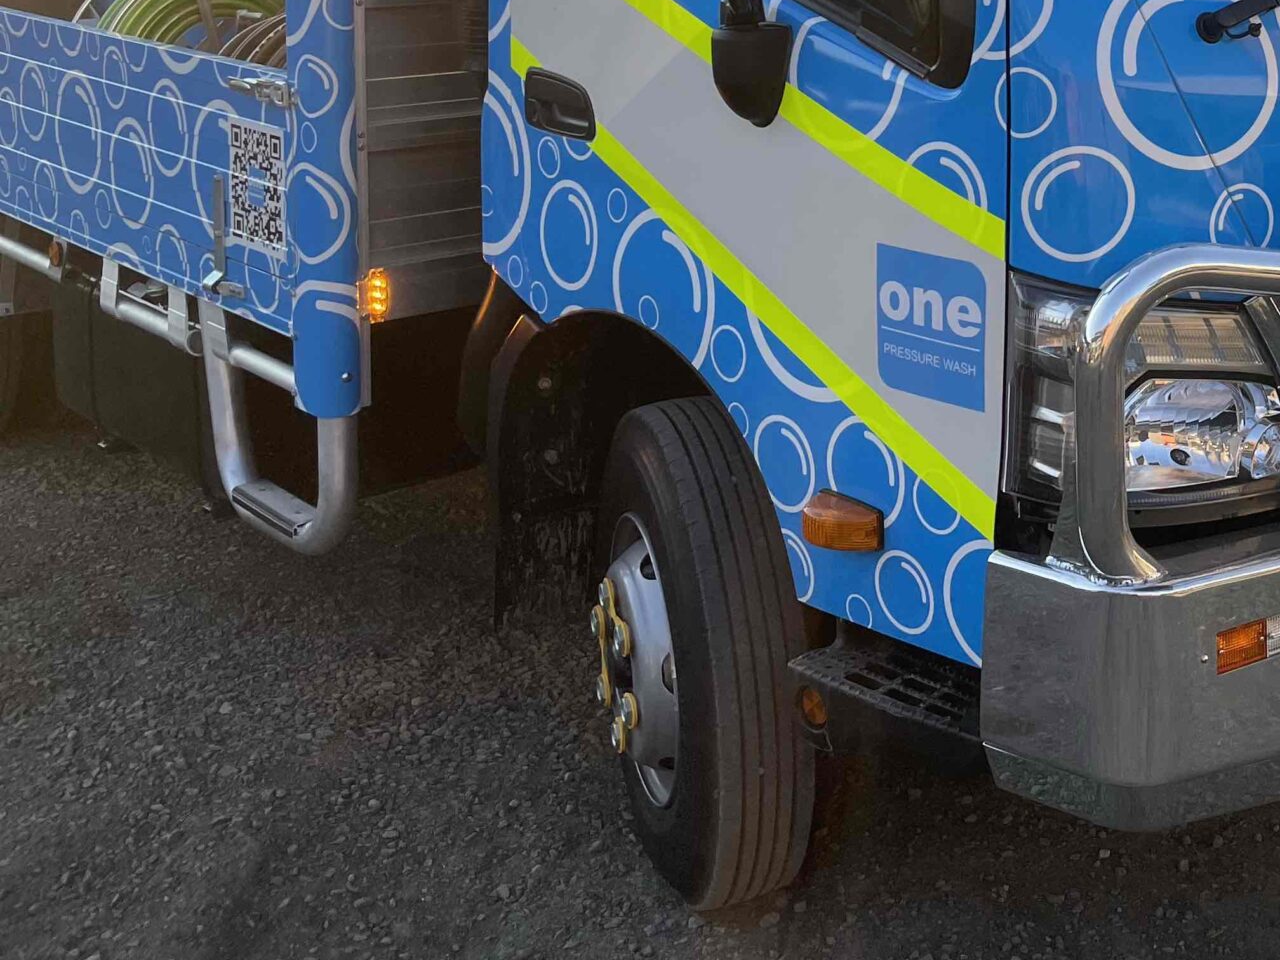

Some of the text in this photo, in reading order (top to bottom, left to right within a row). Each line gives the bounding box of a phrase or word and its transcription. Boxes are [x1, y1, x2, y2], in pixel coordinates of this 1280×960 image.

[879, 280, 982, 338] one
[883, 342, 977, 376] PRESSURE WASH
